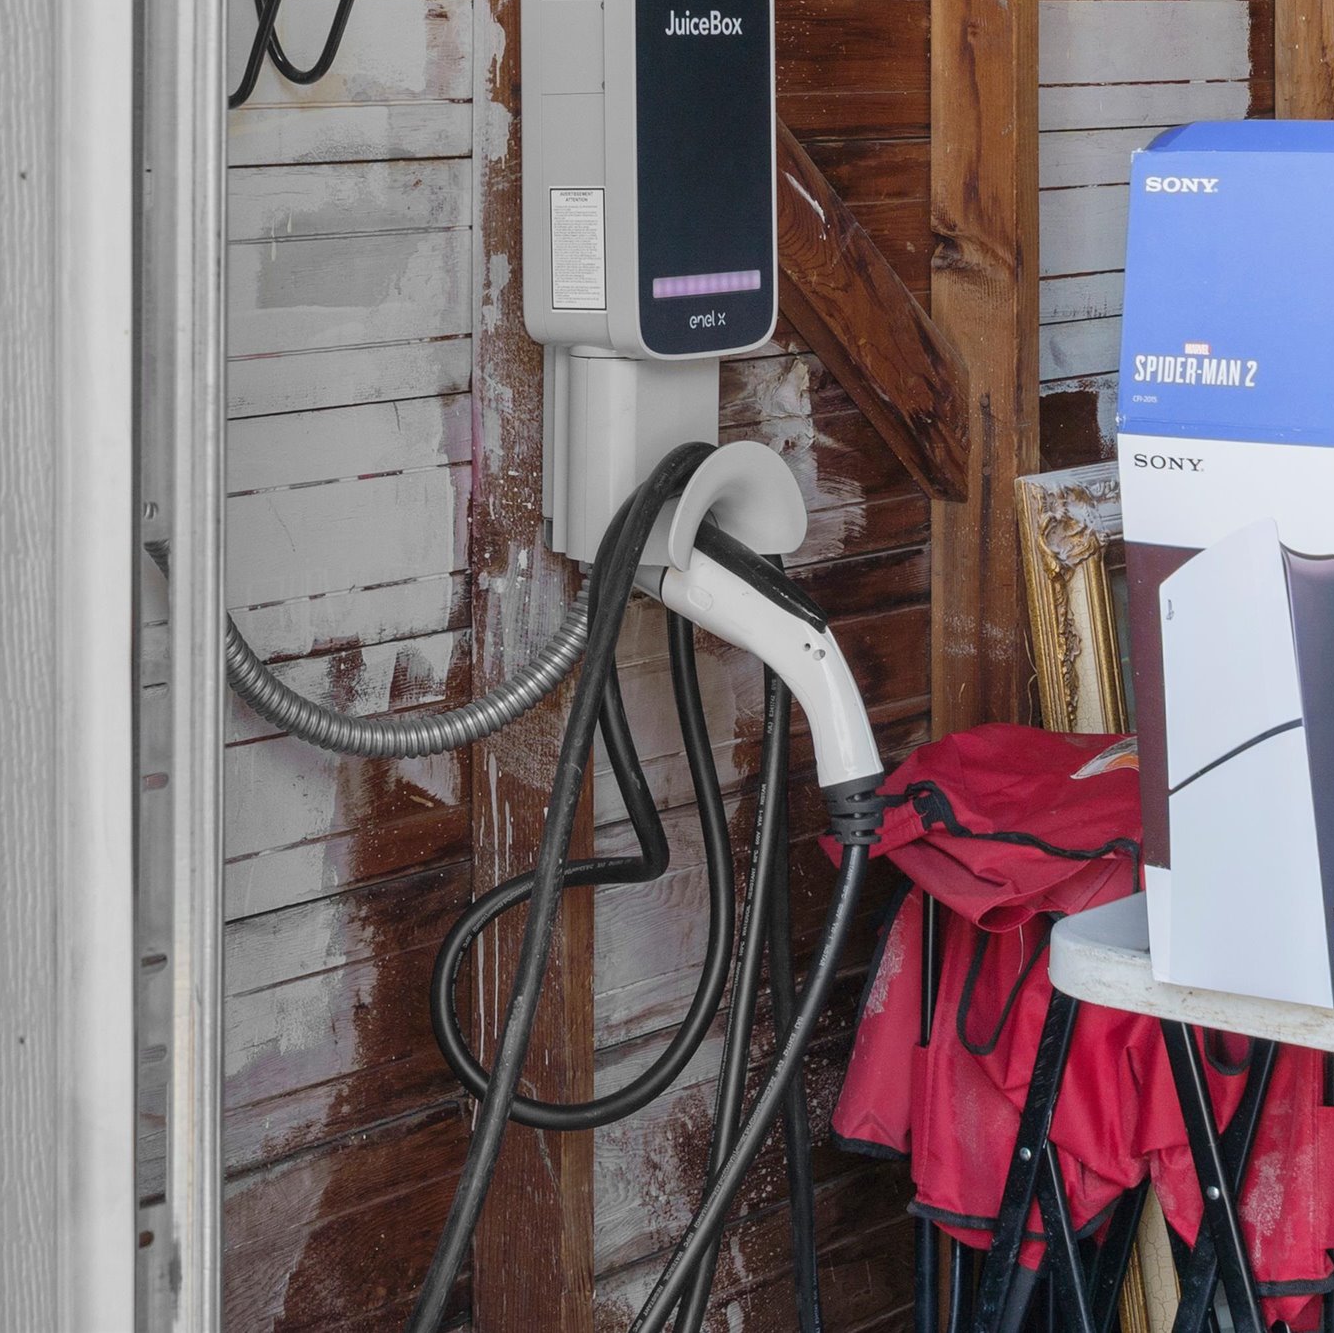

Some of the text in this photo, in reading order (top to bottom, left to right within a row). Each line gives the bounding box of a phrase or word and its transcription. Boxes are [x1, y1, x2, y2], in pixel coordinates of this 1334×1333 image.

[665, 10, 743, 37] JuiceBox
[1145, 177, 1218, 193] SONY
[689, 310, 715, 329] enel
[1184, 342, 1210, 355] MARVEL
[1134, 355, 1258, 388] SPIDER-MAN 2
[1134, 454, 1203, 472] SONY
